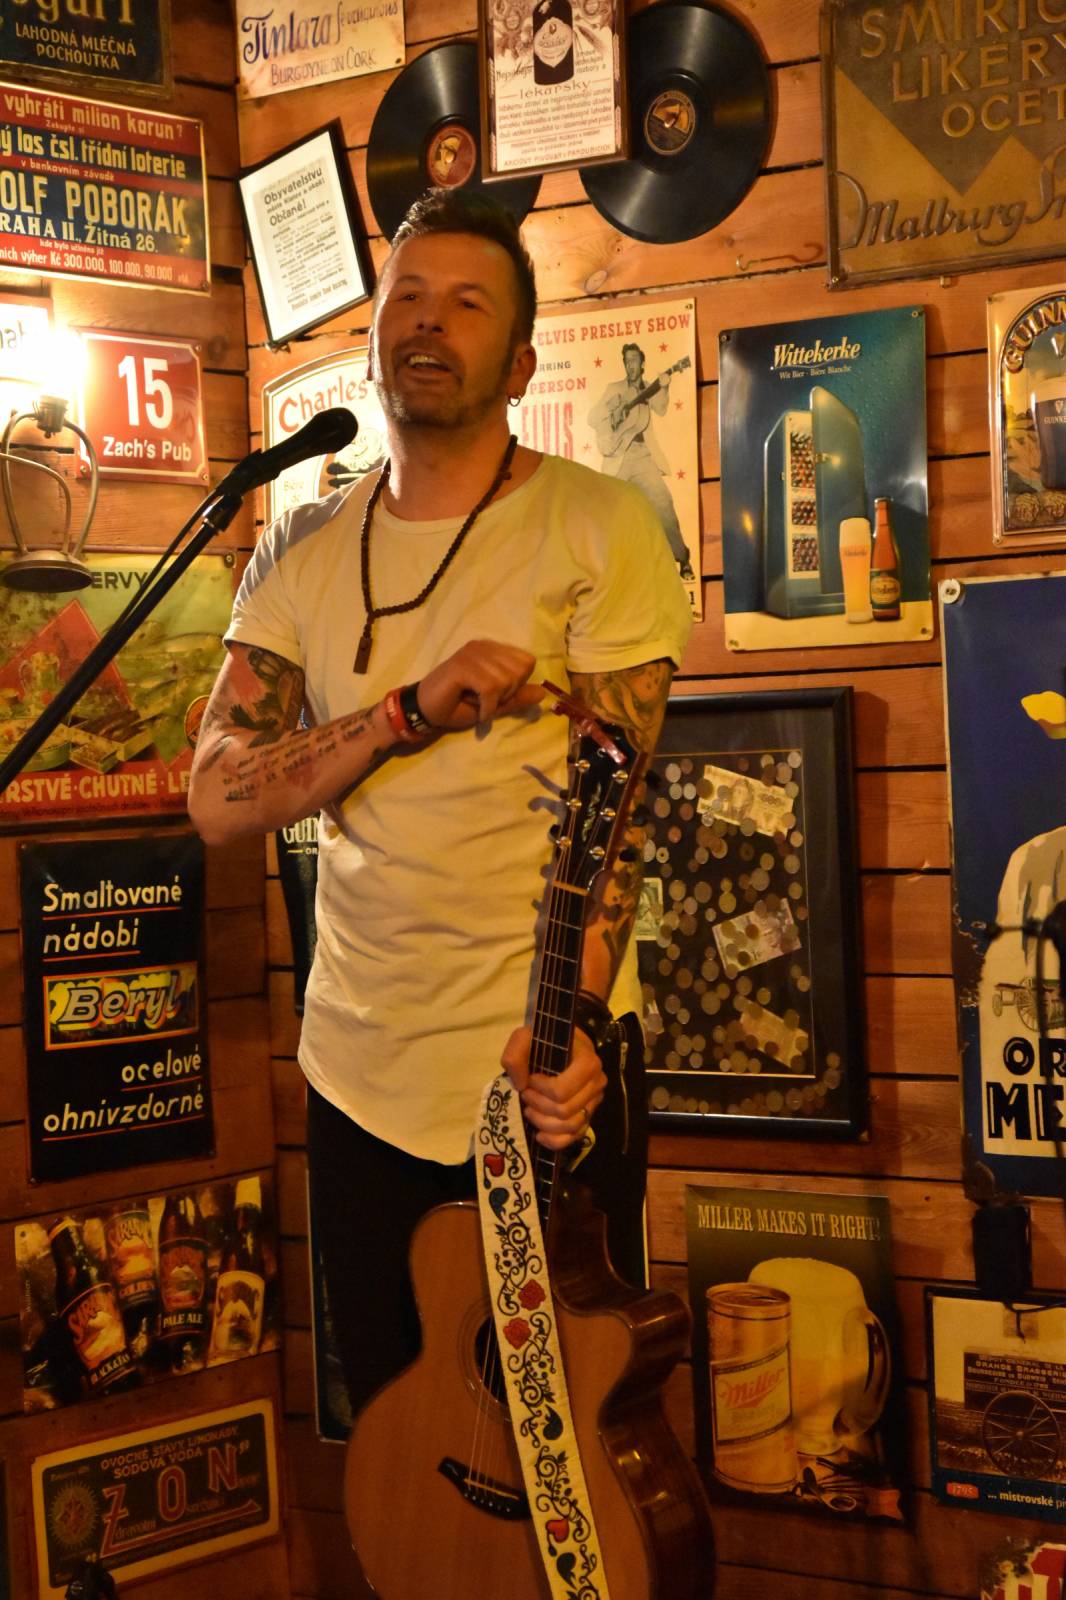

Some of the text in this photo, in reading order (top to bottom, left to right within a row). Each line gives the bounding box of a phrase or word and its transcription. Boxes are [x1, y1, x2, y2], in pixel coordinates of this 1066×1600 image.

[15, 22, 137, 57] LAHODNÁ MLÉČNÁ
[36, 42, 120, 71] POCHOUTKA
[346, 46, 378, 71] CORK
[4, 93, 65, 120] vyhráti
[72, 105, 121, 131] milion
[127, 113, 175, 140] korun
[17, 127, 44, 156] los
[50, 133, 79, 161] čsl.
[81, 138, 128, 171] třídní
[130, 146, 187, 179] loterie
[30, 157, 80, 177] bankovním
[264, 167, 323, 206] Obyvatelstvu
[65, 178, 189, 236] POBORÁK
[269, 198, 307, 227] Občané!
[84, 220, 132, 249] Žitná
[135, 232, 159, 253] 26.
[20, 251, 48, 266] výher
[50, 251, 62, 267] Kč
[536, 313, 691, 347] ELVIS PRESLEY SHOW
[537, 360, 572, 373] RRING
[773, 336, 861, 369] Wittekerke
[117, 354, 173, 430] 15
[530, 376, 587, 396] PERSON
[278, 375, 369, 433] Charles
[103, 435, 192, 462] Zach's Pub
[0, 772, 72, 804] RSTVÉ
[79, 769, 158, 800] CHUTNÉ
[42, 874, 183, 913] Smaltované
[55, 970, 181, 1030] Beryl
[121, 1044, 203, 1084] ocelové
[43, 1087, 205, 1133] ohnivzdorné
[697, 1204, 754, 1232] MILLER
[756, 1208, 806, 1236] MAKES
[811, 1213, 826, 1238] IT
[163, 1313, 203, 1329] PALE ALE
[999, 1490, 1054, 1507] mistrovské
